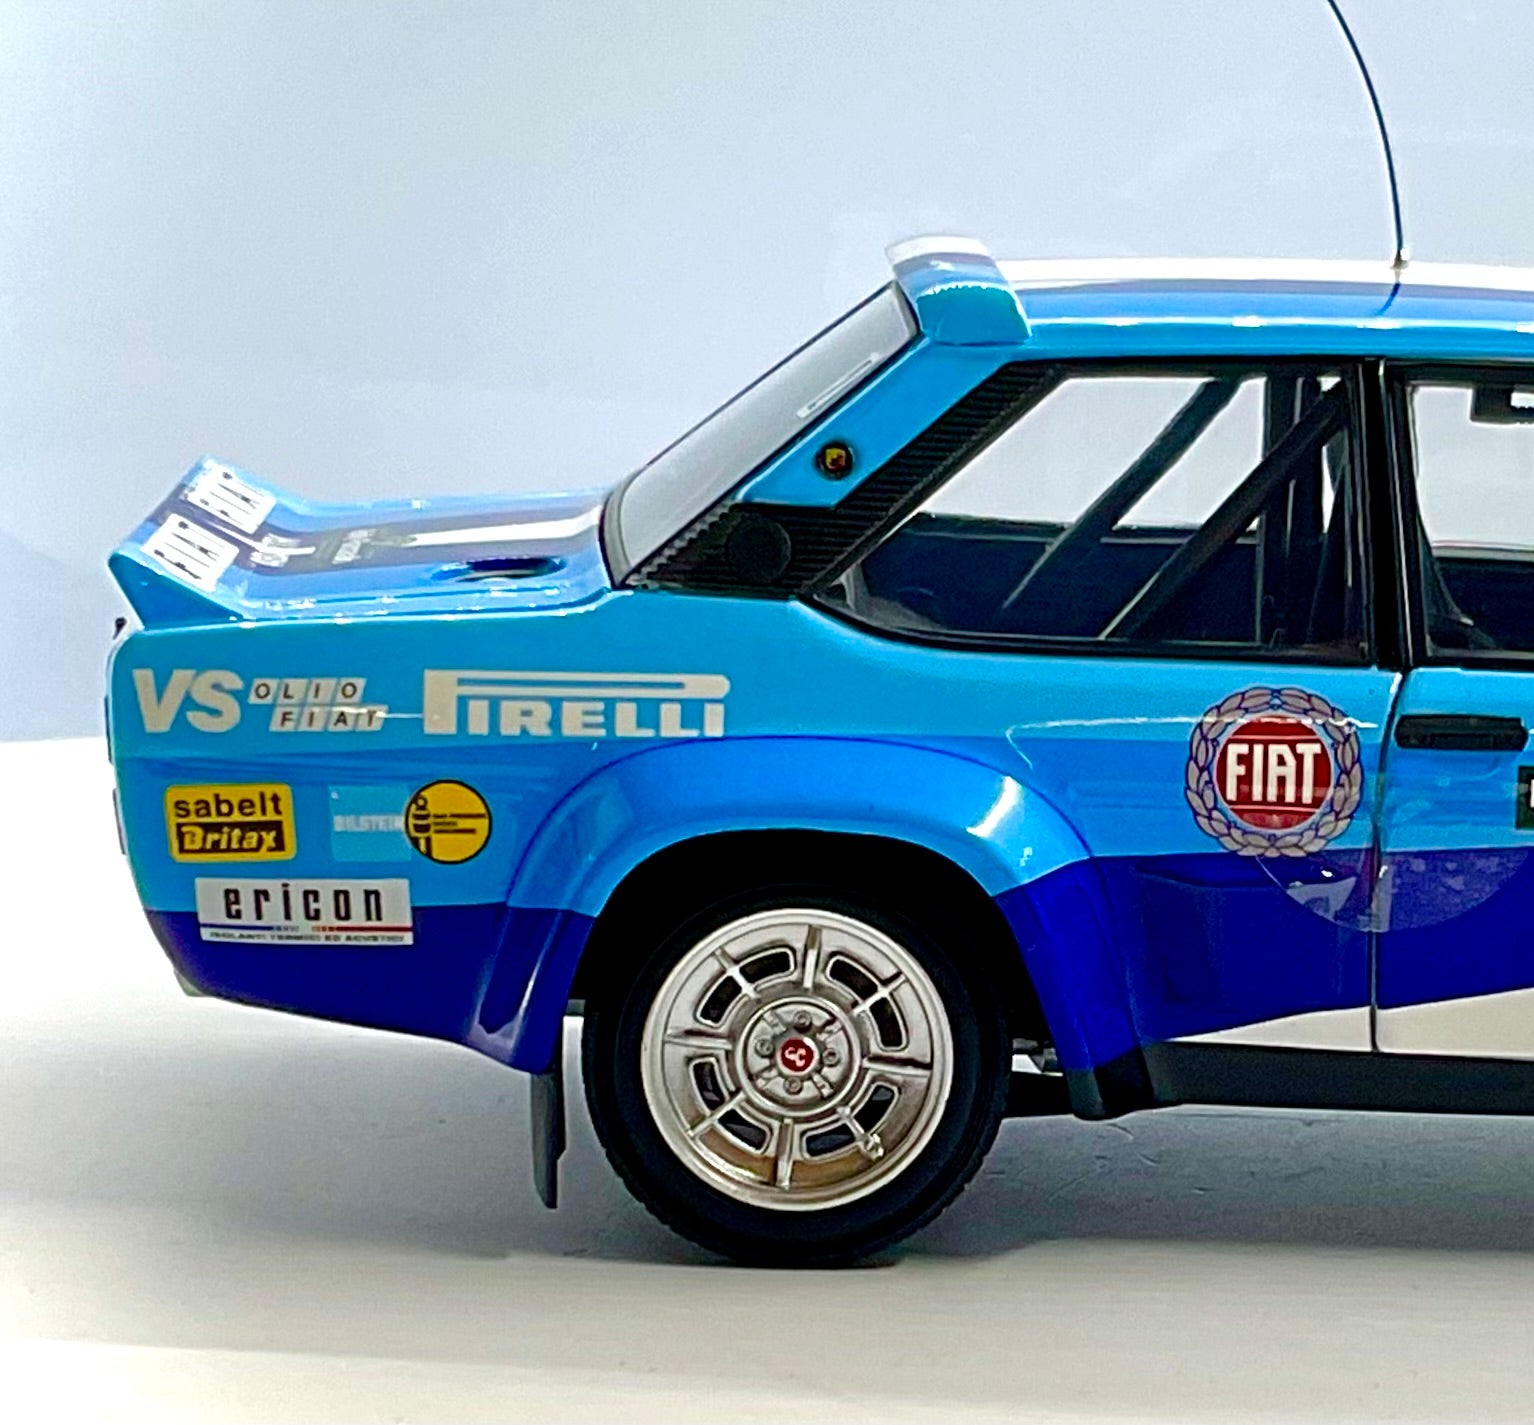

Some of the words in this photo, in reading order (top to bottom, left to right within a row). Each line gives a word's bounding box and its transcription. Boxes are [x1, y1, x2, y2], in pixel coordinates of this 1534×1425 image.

[131, 668, 246, 734] VS
[252, 680, 359, 700] OLIO
[423, 668, 730, 737] PIRELLI
[279, 709, 379, 728] FIAT
[1225, 742, 1322, 804] FIAT
[173, 790, 283, 818] sabelt
[180, 823, 278, 853] Britax
[223, 882, 383, 922] ericon
